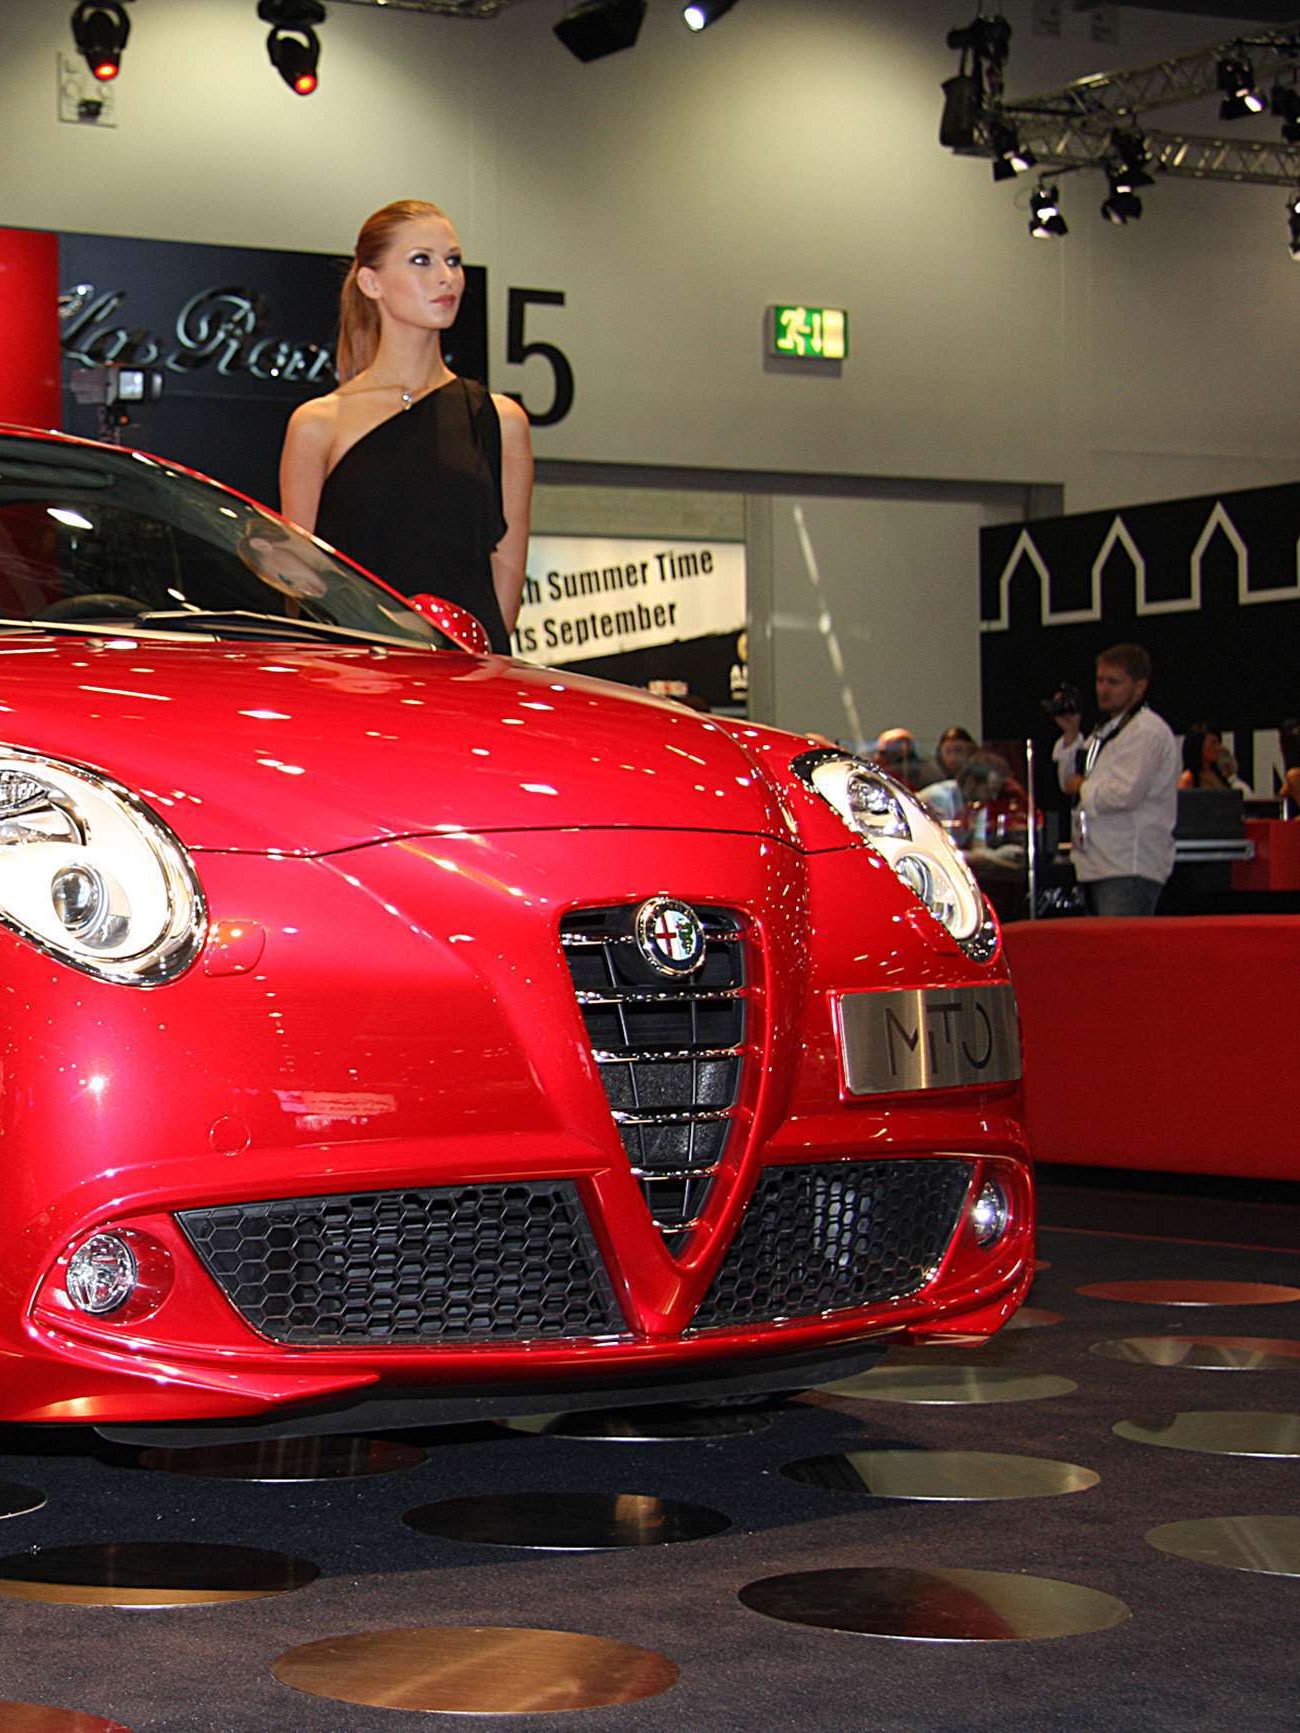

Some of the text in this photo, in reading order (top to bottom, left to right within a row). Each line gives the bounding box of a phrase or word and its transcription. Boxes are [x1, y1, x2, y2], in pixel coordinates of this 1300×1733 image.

[507, 286, 575, 427] 5
[547, 562, 649, 601] Summer
[655, 549, 714, 583] Time
[544, 601, 677, 648] September
